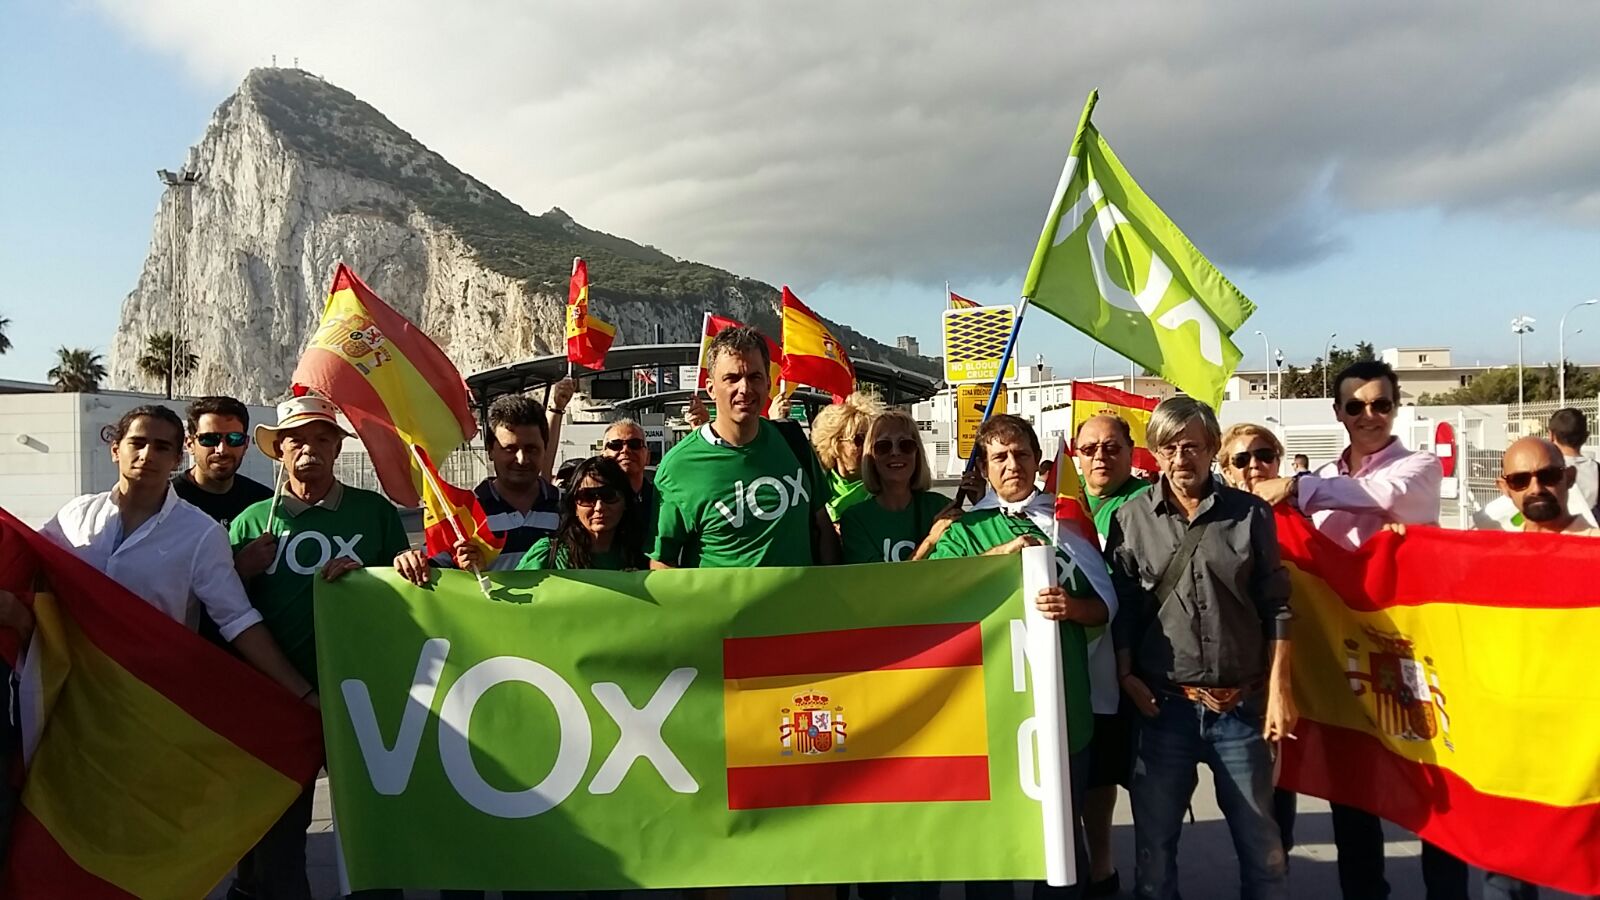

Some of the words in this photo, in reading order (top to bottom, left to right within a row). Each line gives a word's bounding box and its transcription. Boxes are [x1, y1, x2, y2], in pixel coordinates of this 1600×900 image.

[952, 363, 962, 371] NO
[715, 467, 810, 528] VOX
[341, 638, 699, 818] VOX
